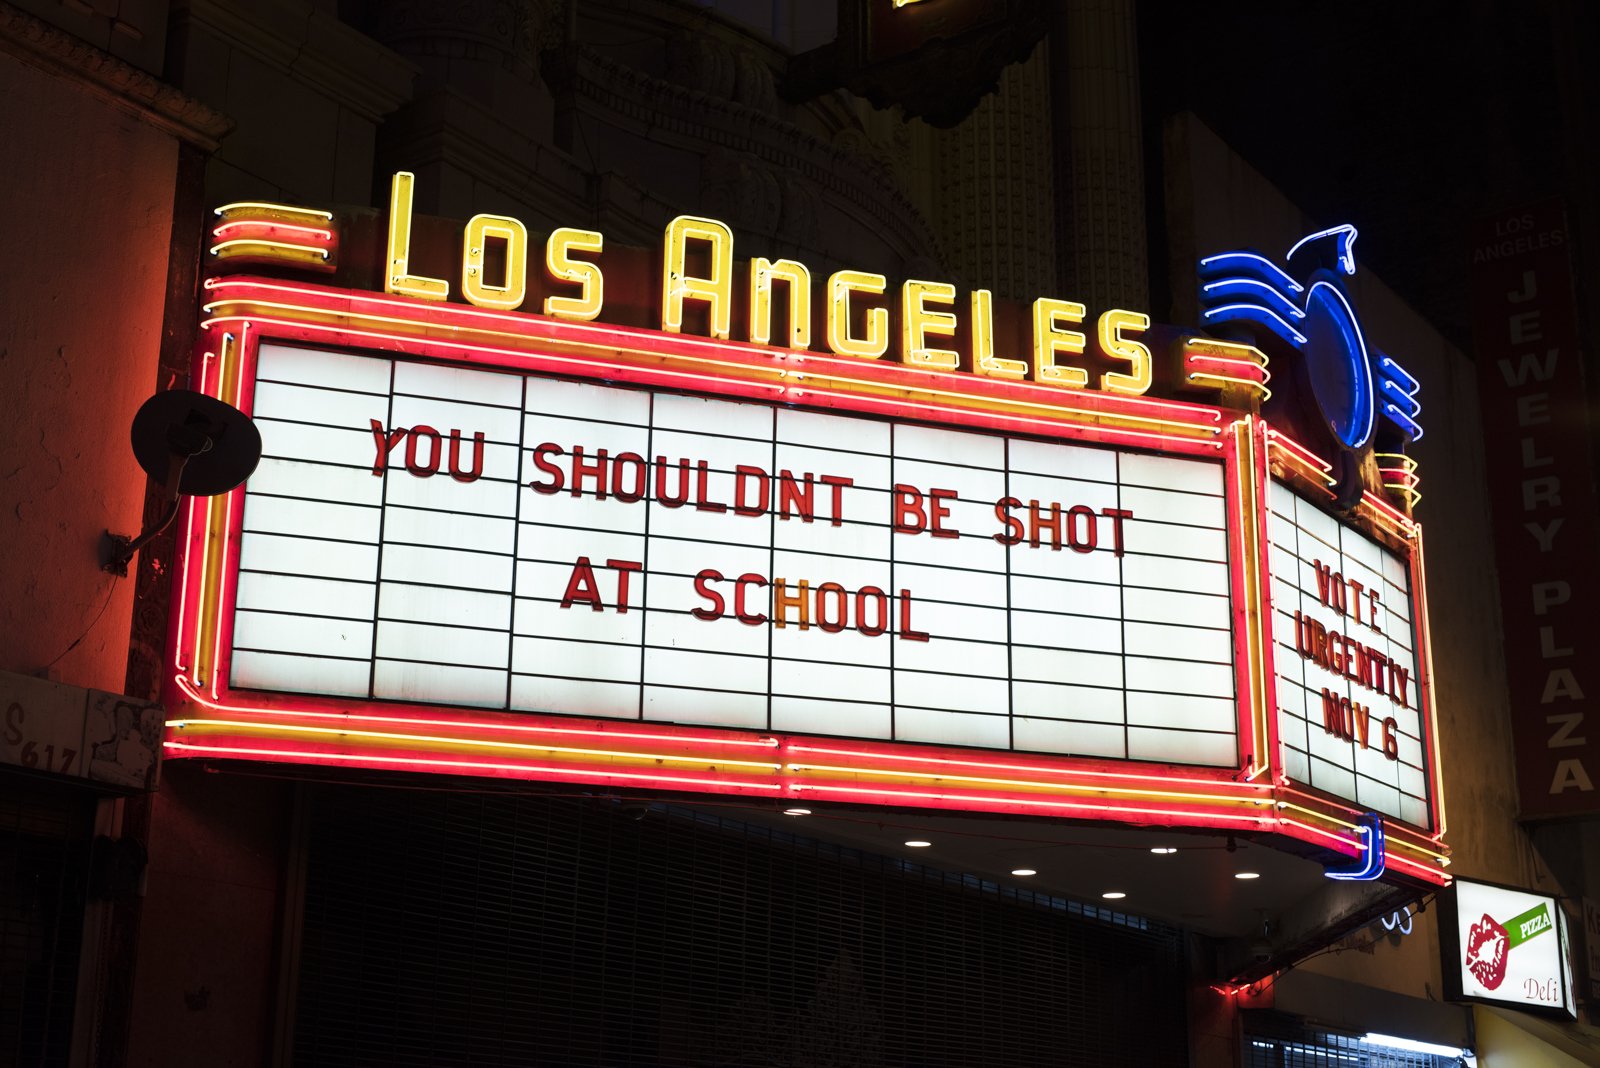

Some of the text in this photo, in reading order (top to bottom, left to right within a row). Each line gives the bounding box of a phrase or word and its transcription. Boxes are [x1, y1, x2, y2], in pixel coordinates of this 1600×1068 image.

[1473, 229, 1564, 264] ANGELES
[1496, 214, 1535, 238] LOS
[385, 172, 1153, 396] LOS ANGELES
[370, 418, 1134, 558] YOU SHOULDNT BE SHOT
[1497, 270, 1595, 795] JEWELRY PLAZA
[560, 556, 930, 644] AT SCHOOL
[1313, 558, 1381, 636] VOTE
[1294, 609, 1410, 710] URGENTLY
[20, 741, 78, 774] 617
[1321, 687, 1399, 762] NOV 6
[1519, 912, 1552, 940] PIZZA
[1523, 977, 1559, 1002] Deli
